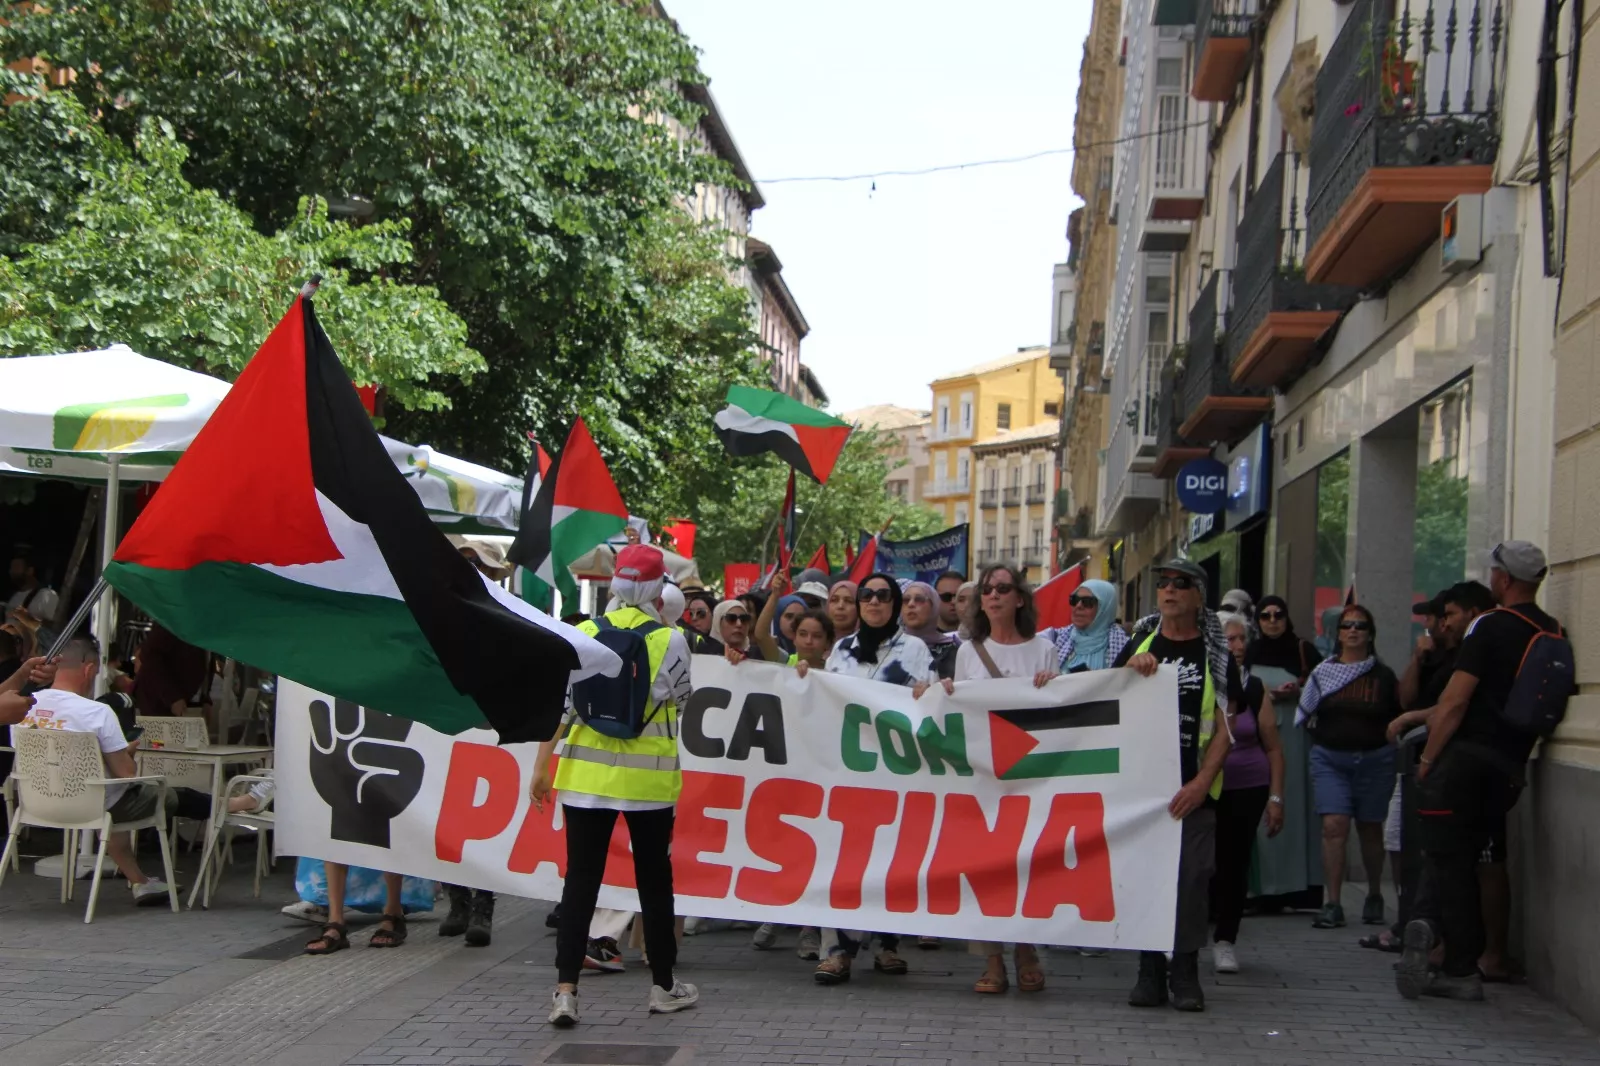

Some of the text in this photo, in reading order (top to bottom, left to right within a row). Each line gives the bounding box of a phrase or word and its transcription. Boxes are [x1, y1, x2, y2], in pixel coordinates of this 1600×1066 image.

[27, 453, 53, 468] tea
[1185, 475, 1225, 491] DIGI
[841, 703, 974, 777] CON
